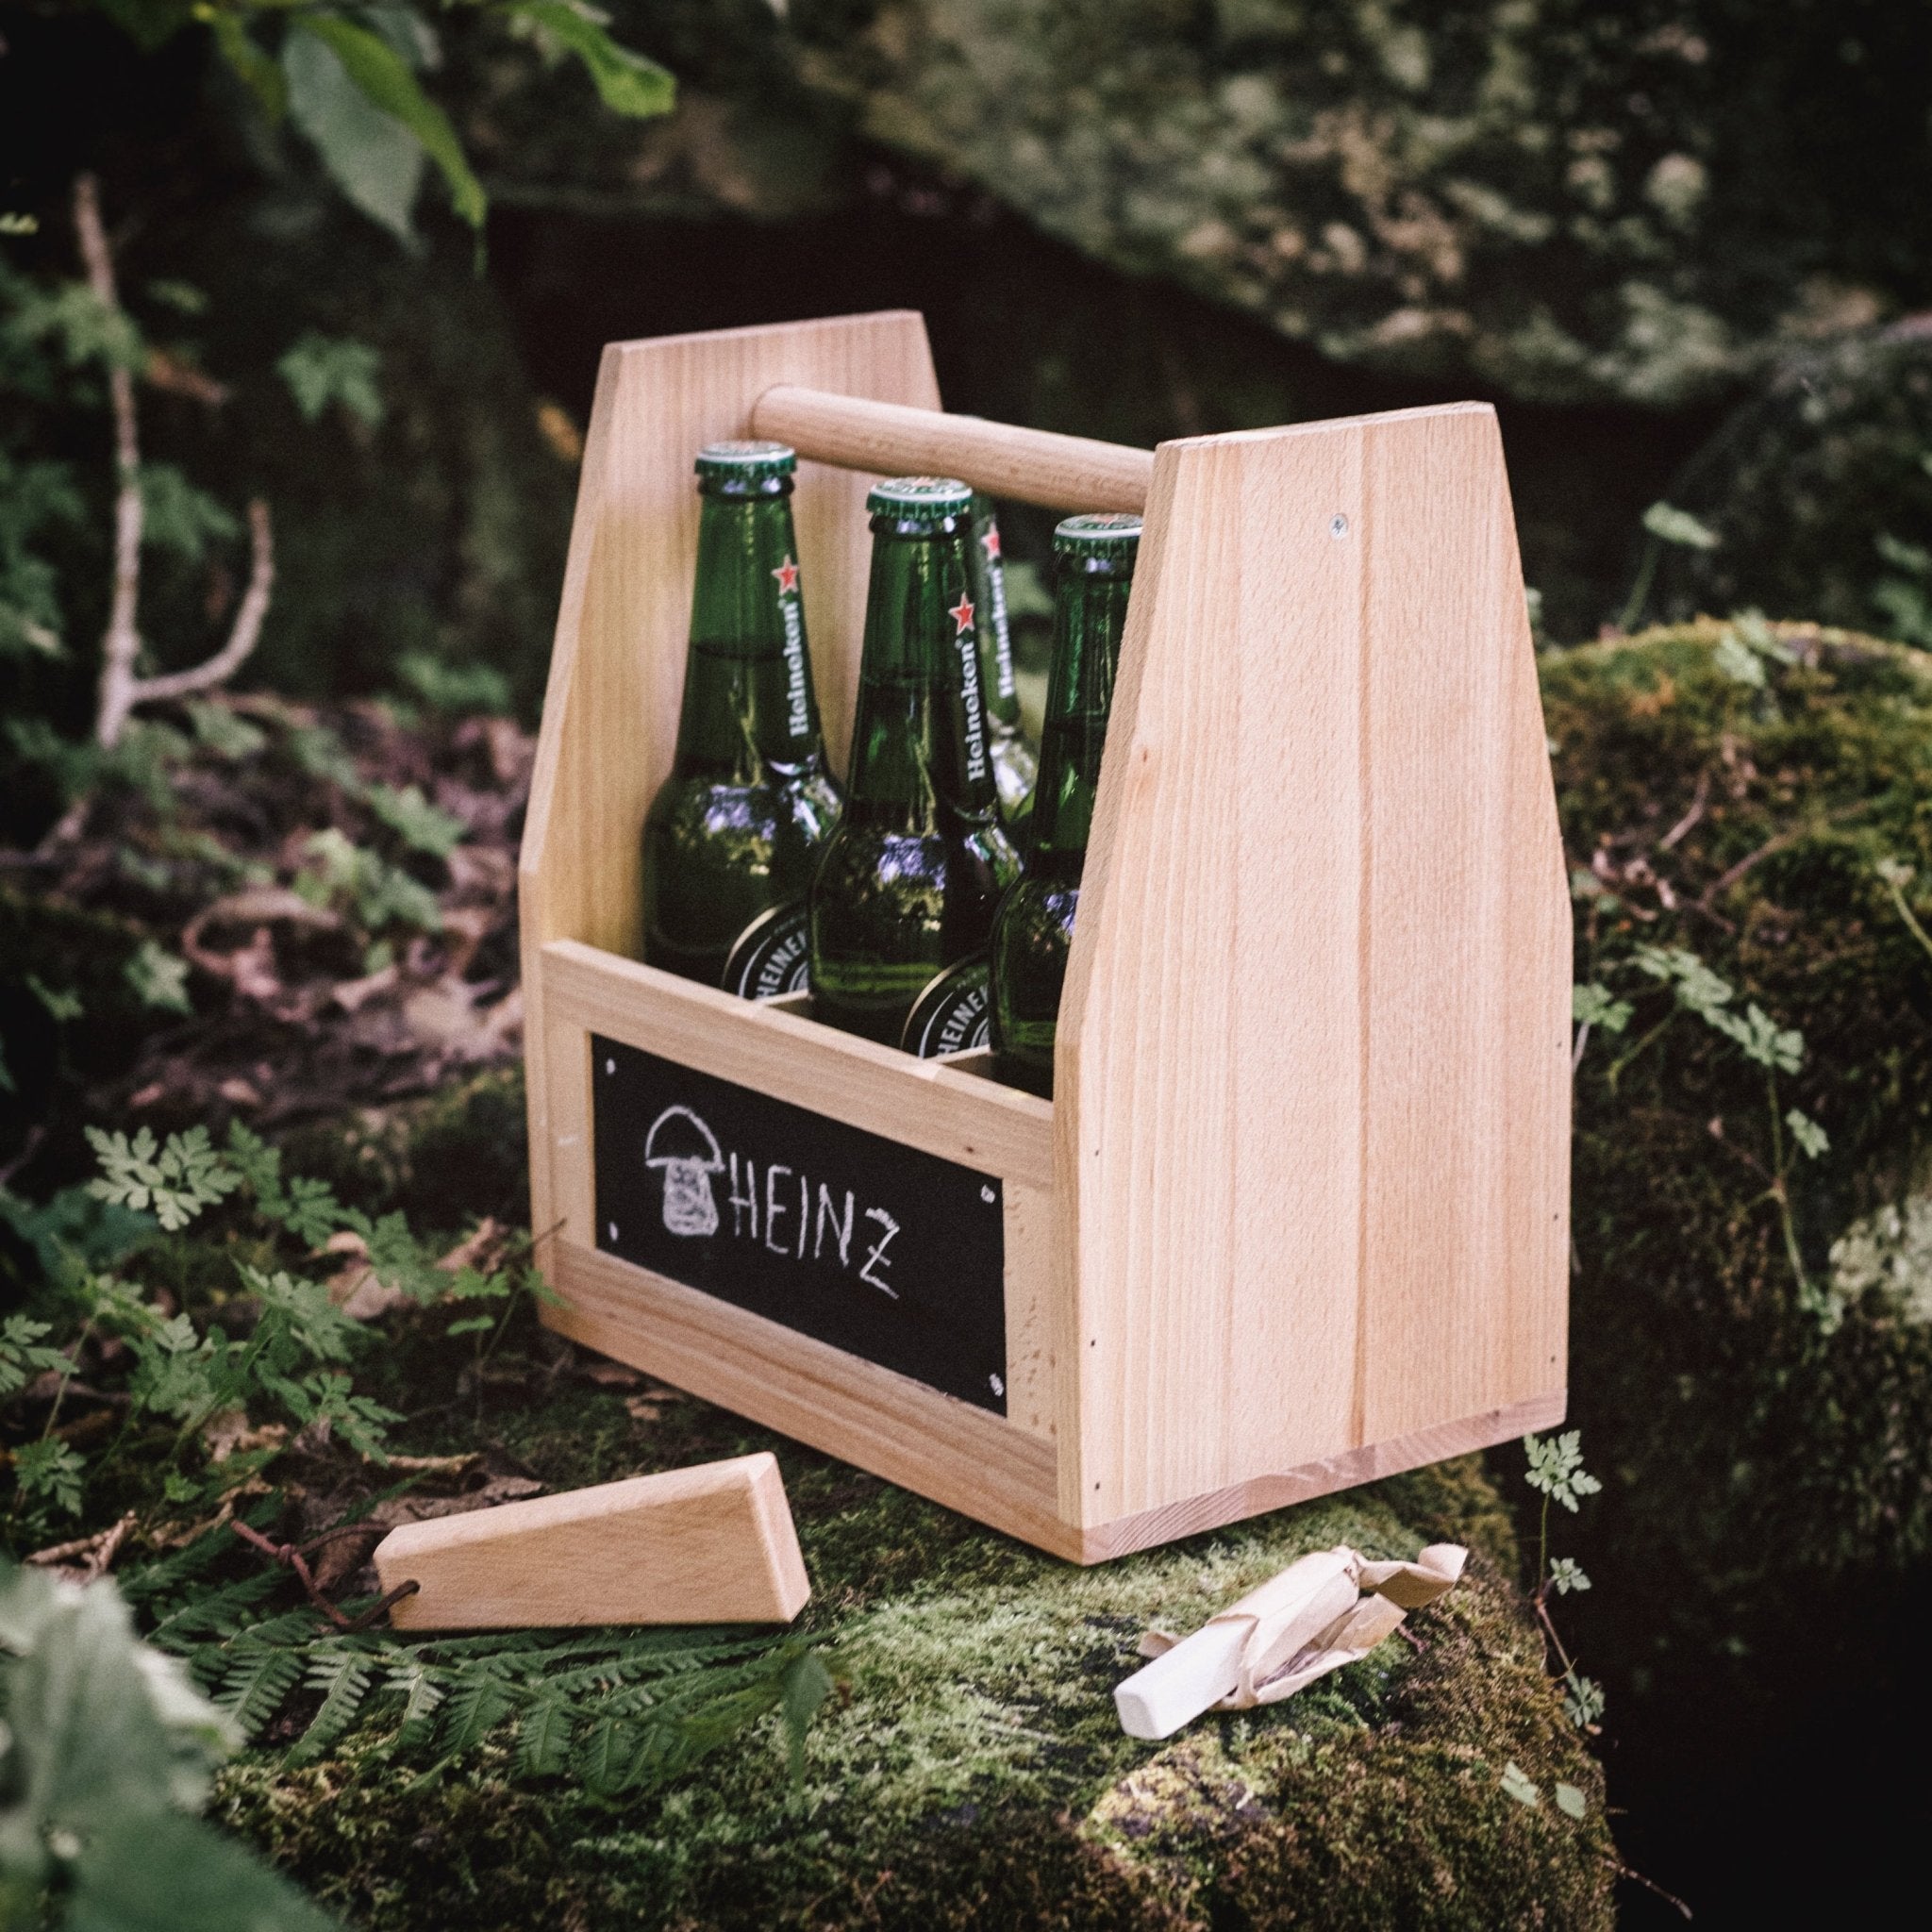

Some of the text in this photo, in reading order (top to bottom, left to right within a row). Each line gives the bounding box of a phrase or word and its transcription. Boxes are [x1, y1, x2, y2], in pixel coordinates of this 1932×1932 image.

[783, 601, 809, 738] Heineken
[960, 641, 986, 782] Heineken
[728, 1152, 900, 1300] HEINZ
